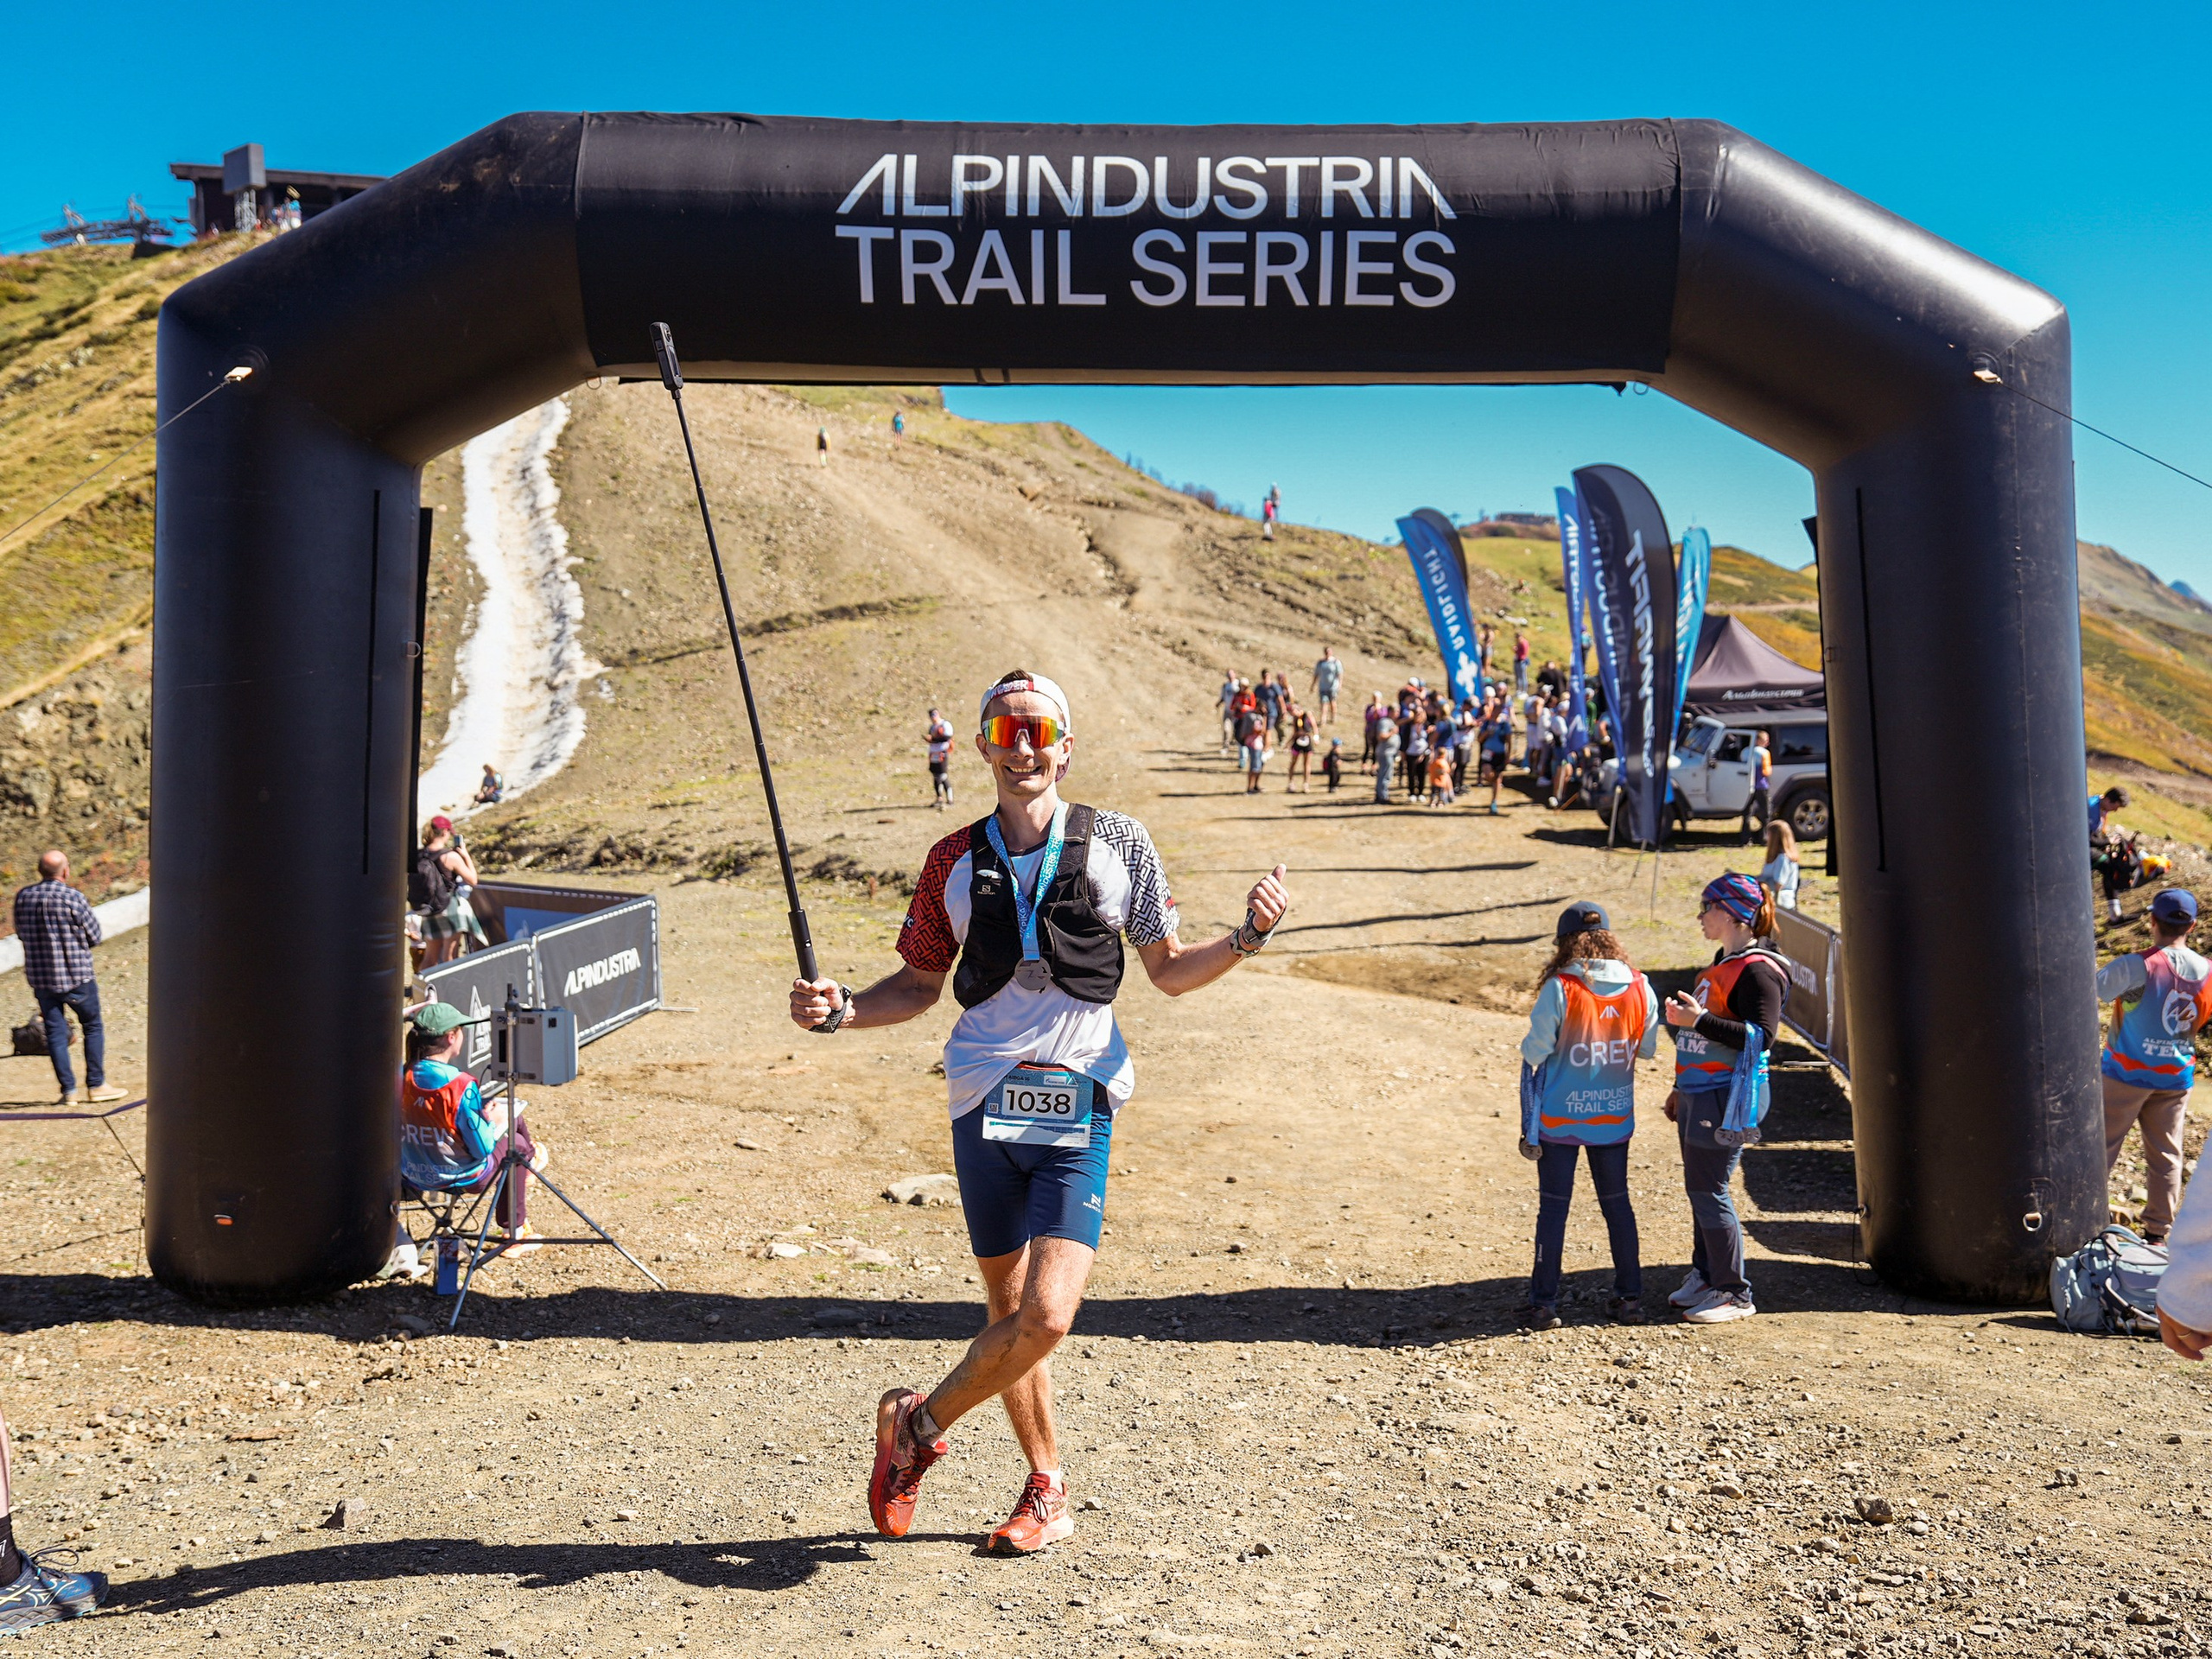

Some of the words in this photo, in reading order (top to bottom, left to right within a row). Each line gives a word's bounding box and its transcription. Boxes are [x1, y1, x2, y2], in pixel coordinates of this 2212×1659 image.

[836, 153, 1457, 219] ALPINDUSTRIA
[836, 224, 1107, 306] TRAIL
[1129, 227, 1457, 308] SERIES
[563, 947, 641, 998] ALPINDUSTRIA
[1007, 1090, 1071, 1115] 1038
[1566, 1102, 1605, 1114] TRAIL
